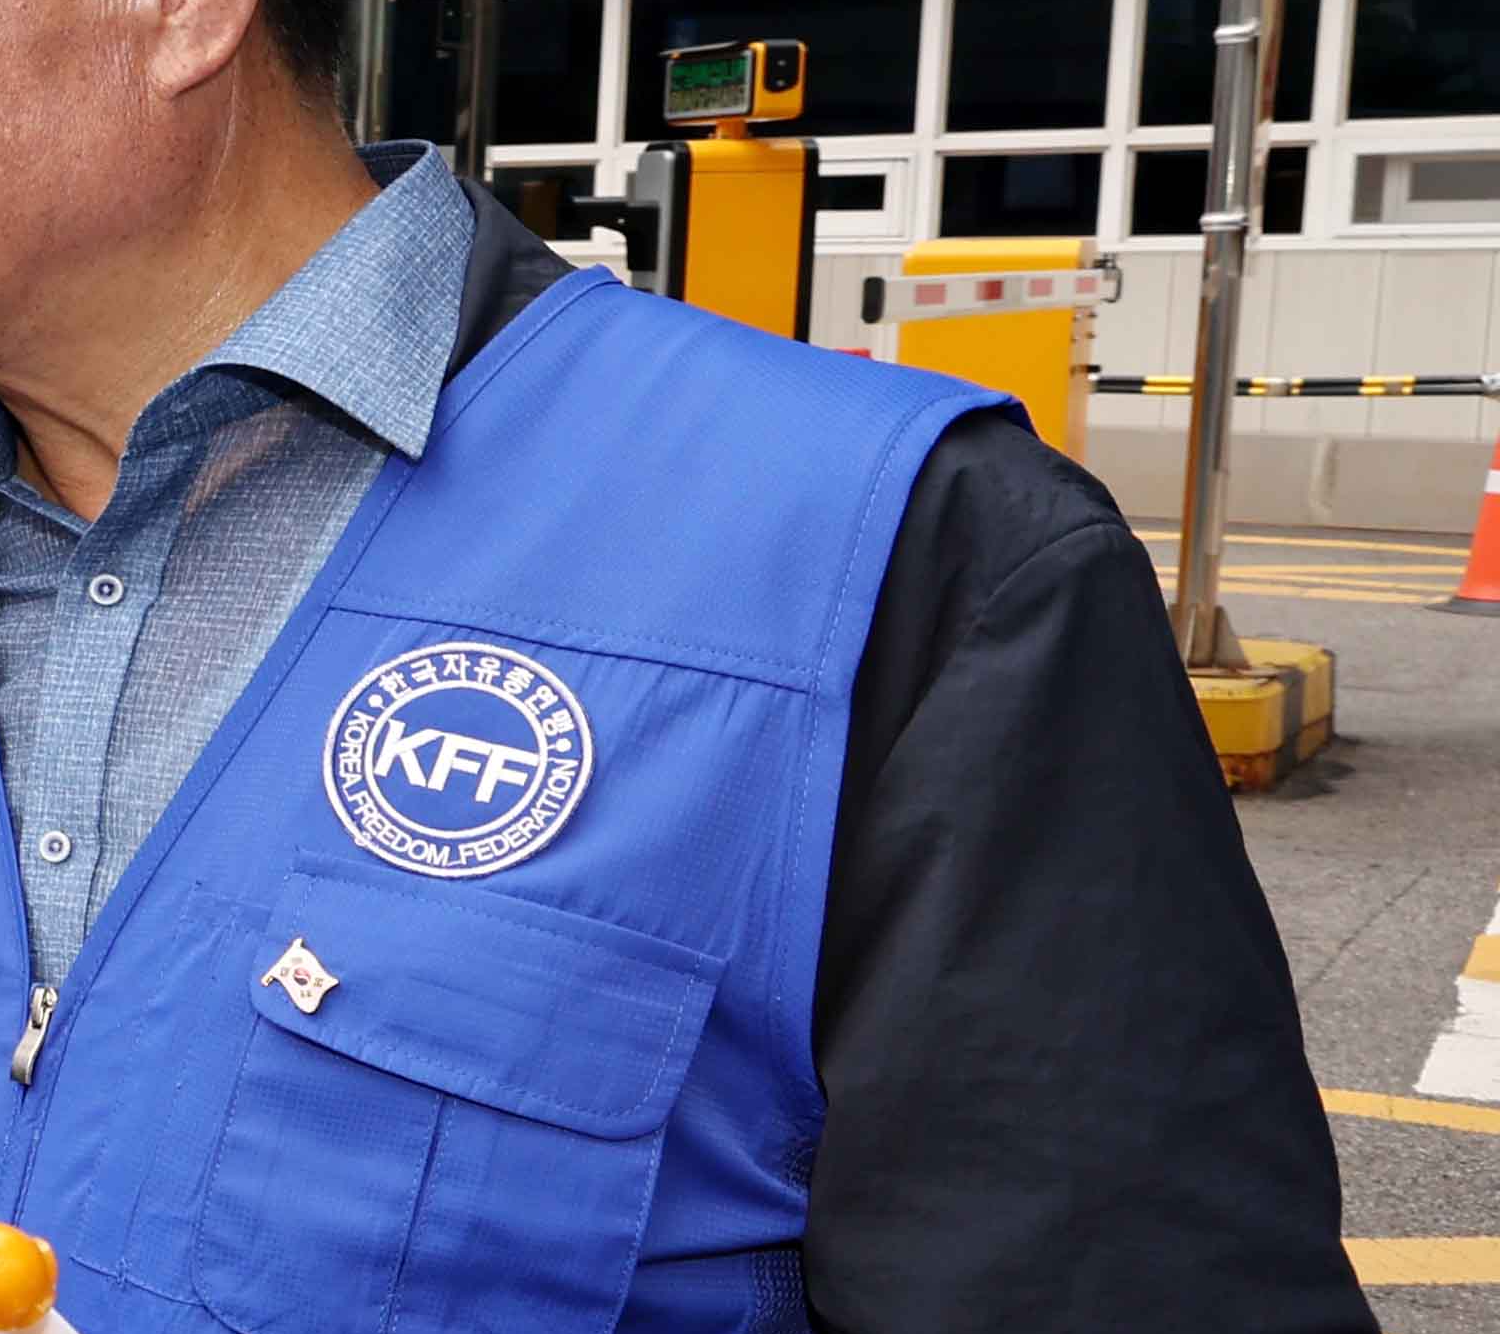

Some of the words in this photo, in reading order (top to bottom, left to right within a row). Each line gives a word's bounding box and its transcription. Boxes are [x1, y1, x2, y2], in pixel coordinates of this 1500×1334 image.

[379, 653, 575, 743] 한국자유총연맹
[373, 718, 540, 803] KFF
[459, 757, 579, 866] FEDERATION
